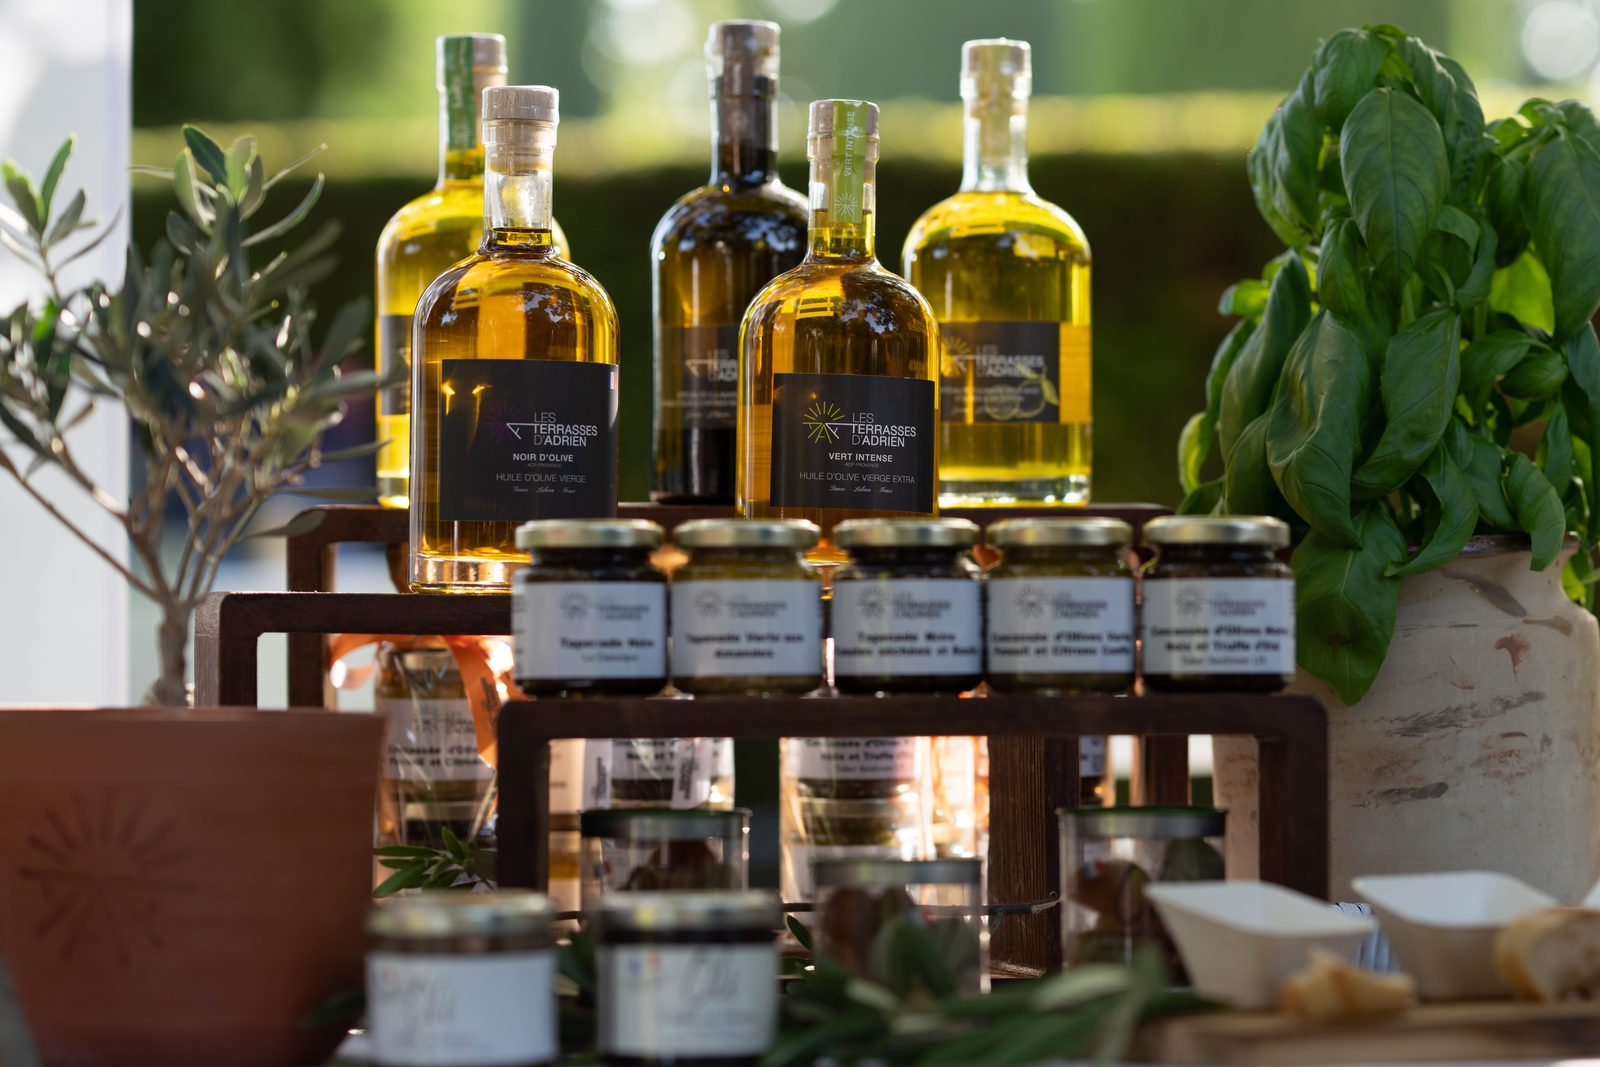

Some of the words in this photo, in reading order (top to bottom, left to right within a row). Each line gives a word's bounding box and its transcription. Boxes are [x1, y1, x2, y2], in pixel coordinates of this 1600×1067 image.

[844, 153, 853, 177] VERT
[976, 353, 1045, 367] TERRASSES
[534, 412, 557, 423] LES
[852, 412, 875, 424] LES
[533, 423, 599, 437] TERRASSES
[852, 423, 917, 437] TERRASSES
[533, 434, 588, 447] D'ADRIEN
[851, 434, 906, 448] D'ADRIEN
[512, 453, 537, 461] NOIR
[539, 453, 575, 462] D'OLIVE
[828, 452, 854, 461] VERT
[855, 453, 894, 463] INTENSE
[496, 473, 523, 482] HUILE
[524, 473, 558, 483] D'OLIVE
[559, 474, 587, 484] VIERGE
[799, 472, 825, 481] HUILE
[826, 472, 860, 482] D'OLIVE
[861, 473, 891, 484] VIERGE
[892, 474, 916, 484] EXTRA
